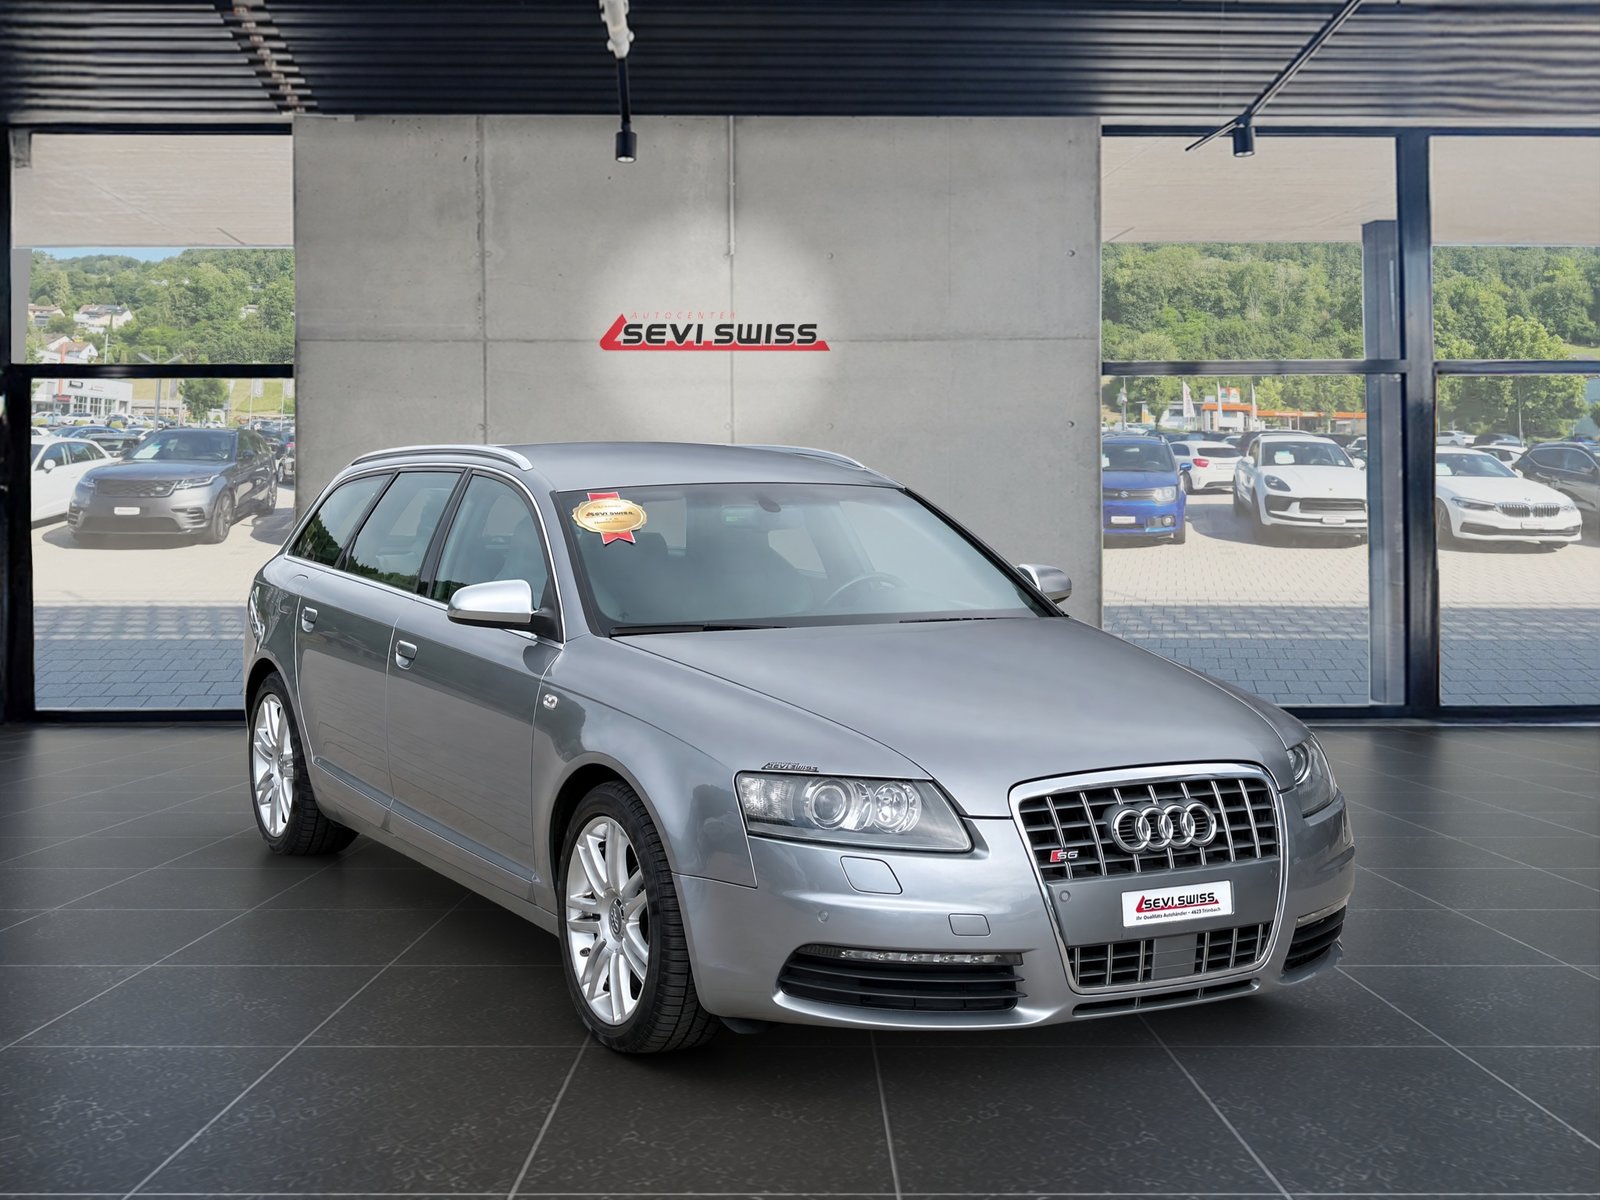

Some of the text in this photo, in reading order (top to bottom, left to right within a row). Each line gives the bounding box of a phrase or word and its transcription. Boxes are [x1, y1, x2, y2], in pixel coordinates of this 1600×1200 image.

[631, 311, 736, 320] AUTOCENTER
[622, 323, 818, 344] SEVI SWISS
[1057, 850, 1079, 860] S6
